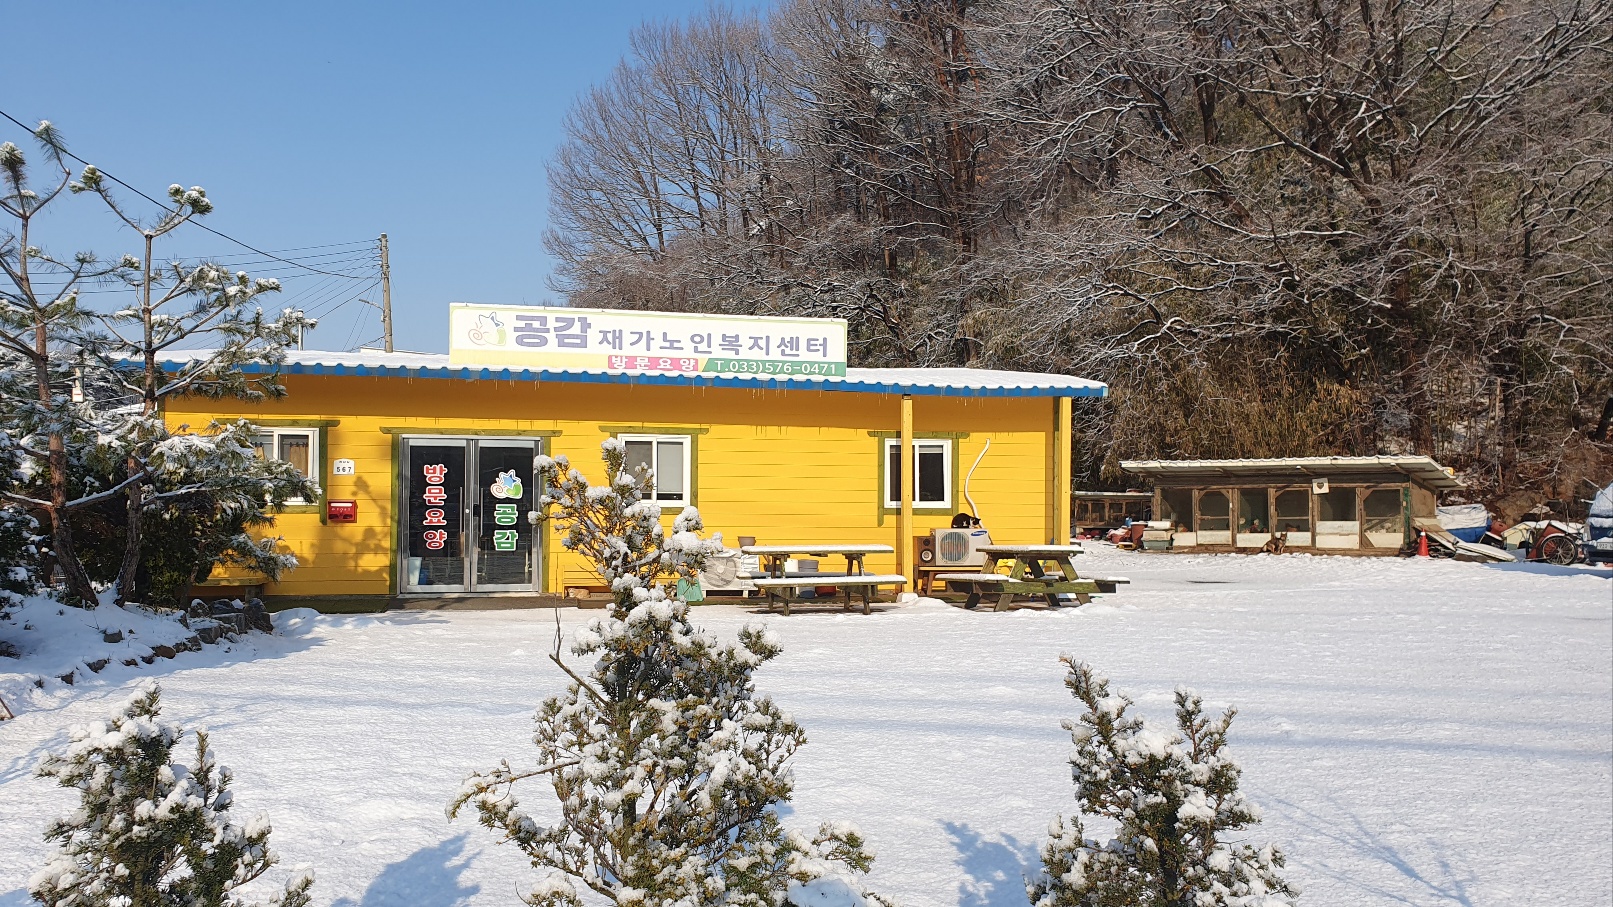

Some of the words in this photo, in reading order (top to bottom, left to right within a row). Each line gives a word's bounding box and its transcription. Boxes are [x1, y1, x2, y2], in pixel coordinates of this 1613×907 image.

[514, 315, 591, 348] 공감
[598, 329, 828, 357] 재가노인복지센터
[611, 355, 696, 371] 방문요양
[715, 360, 836, 375] T.033)576-0471
[423, 463, 448, 550] 방문요양
[493, 503, 518, 552] 공감
